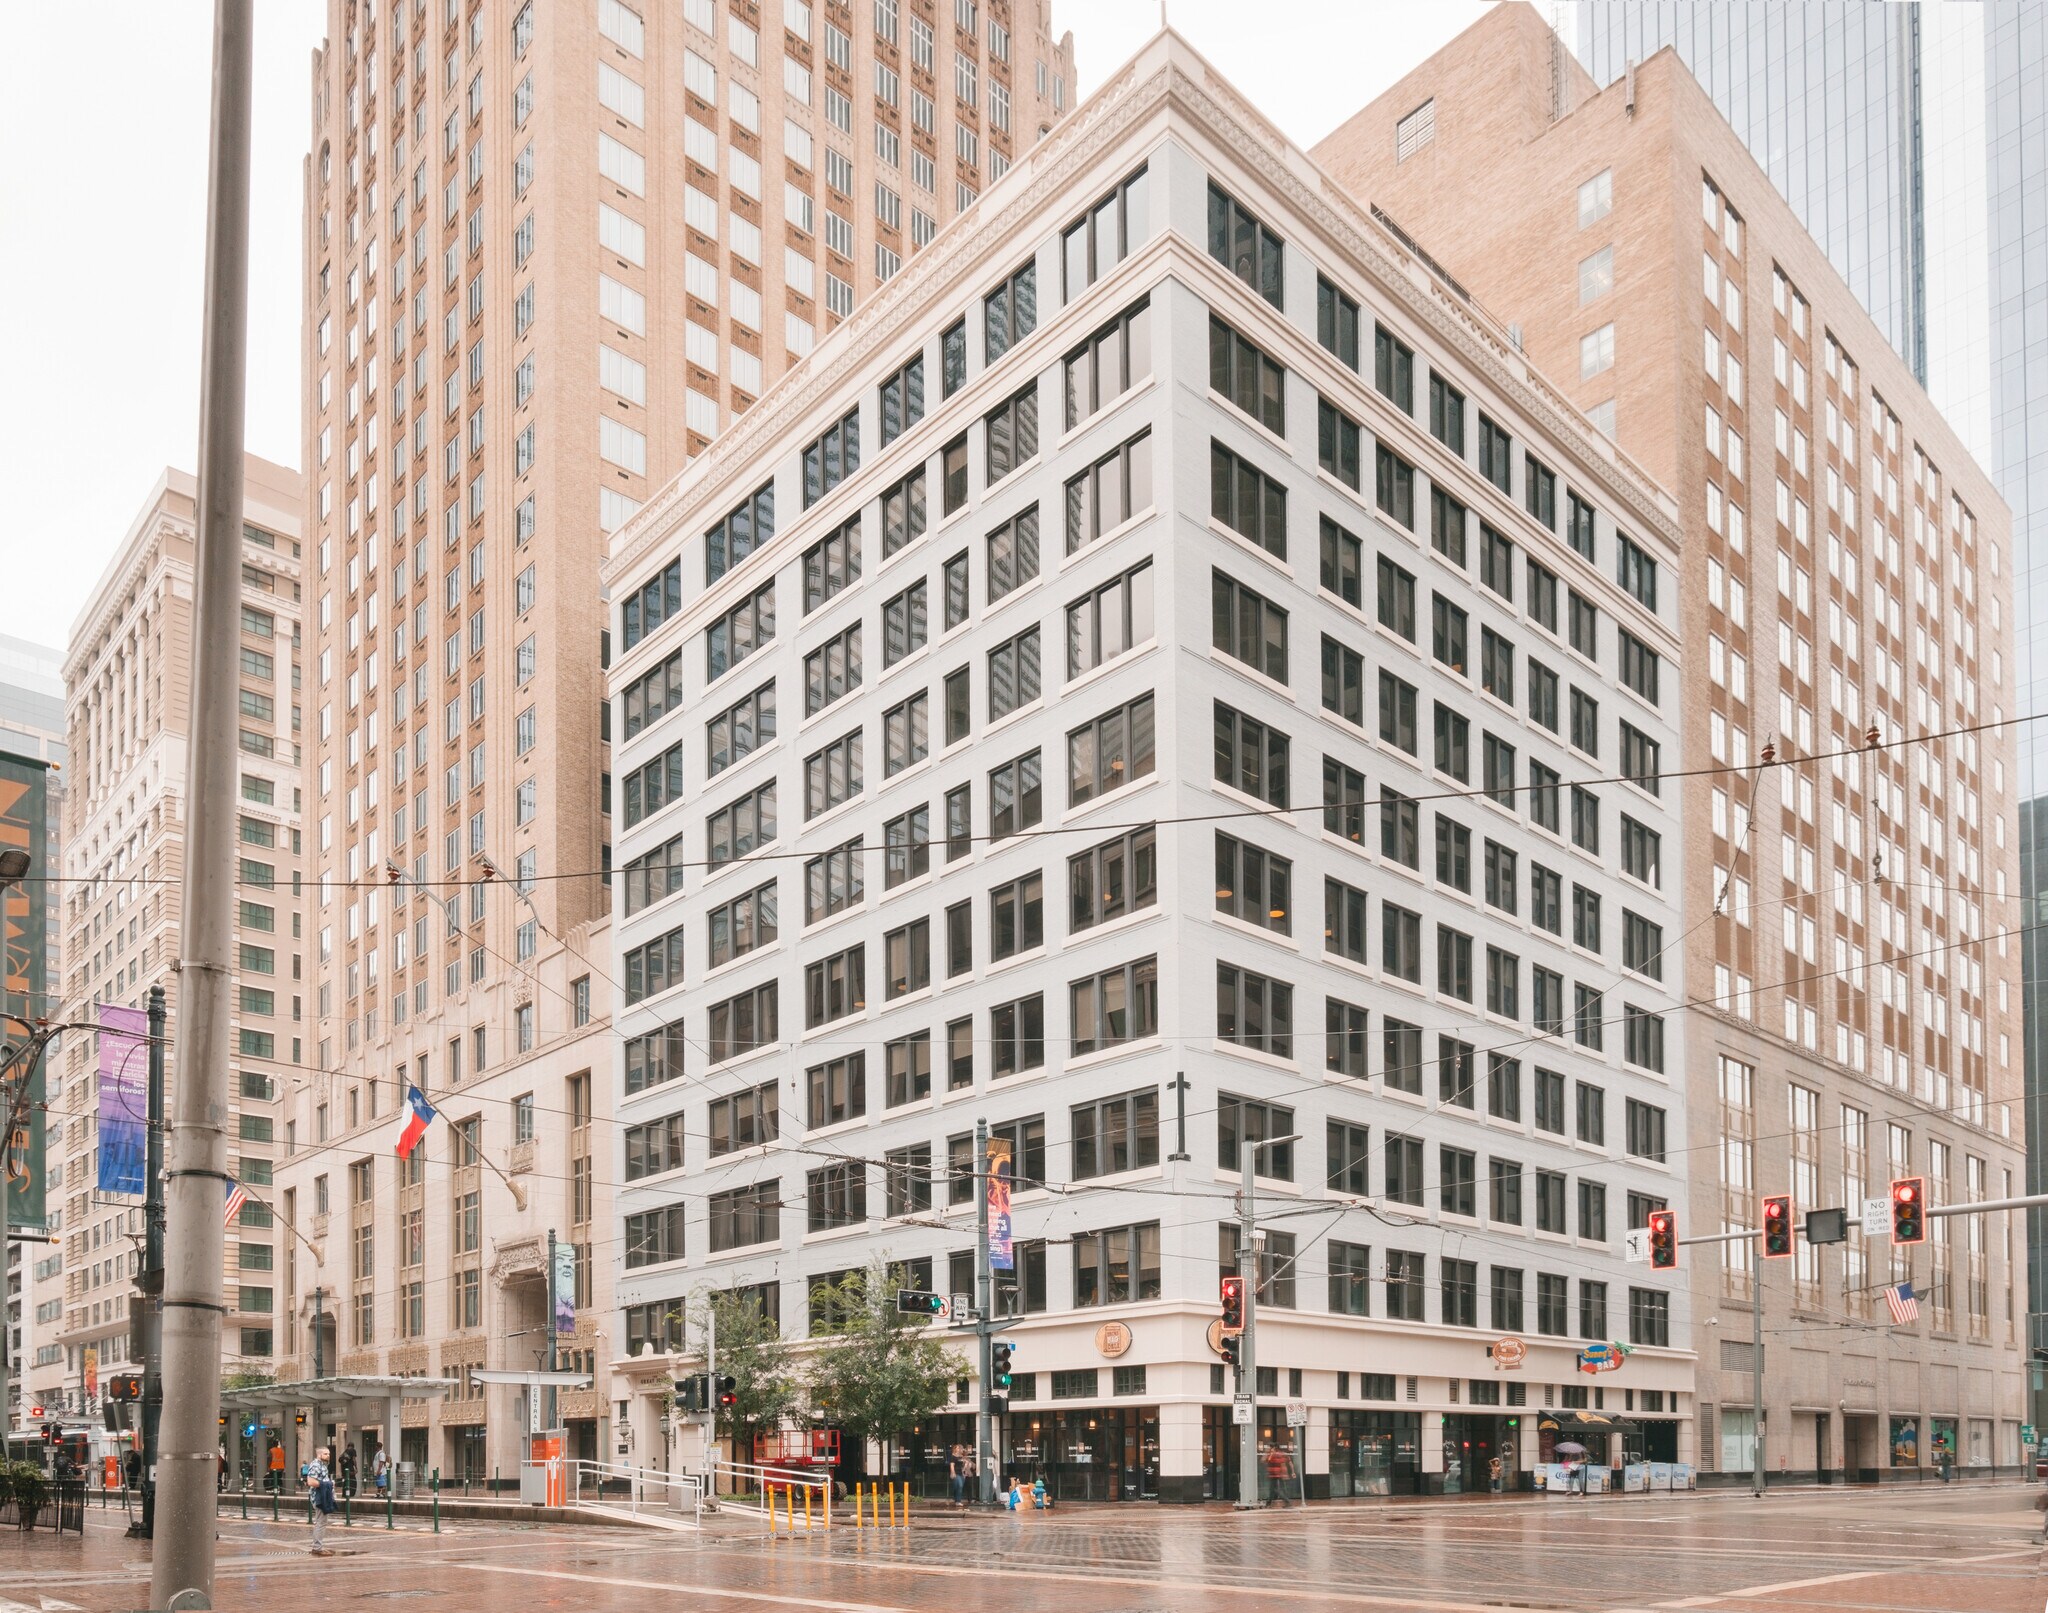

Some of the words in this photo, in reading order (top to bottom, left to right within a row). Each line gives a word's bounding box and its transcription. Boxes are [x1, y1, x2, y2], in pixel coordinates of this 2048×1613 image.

[111, 1060, 145, 1069] mintras
[133, 1081, 145, 1089] los
[101, 1085, 145, 1095] semforos?
[1871, 1201, 1885, 1209] NO
[1867, 1210, 1888, 1218] RIGHT
[1583, 1349, 1613, 1360] Sunny's
[1597, 1359, 1615, 1370] BAR
[130, 1381, 138, 1395] 5
